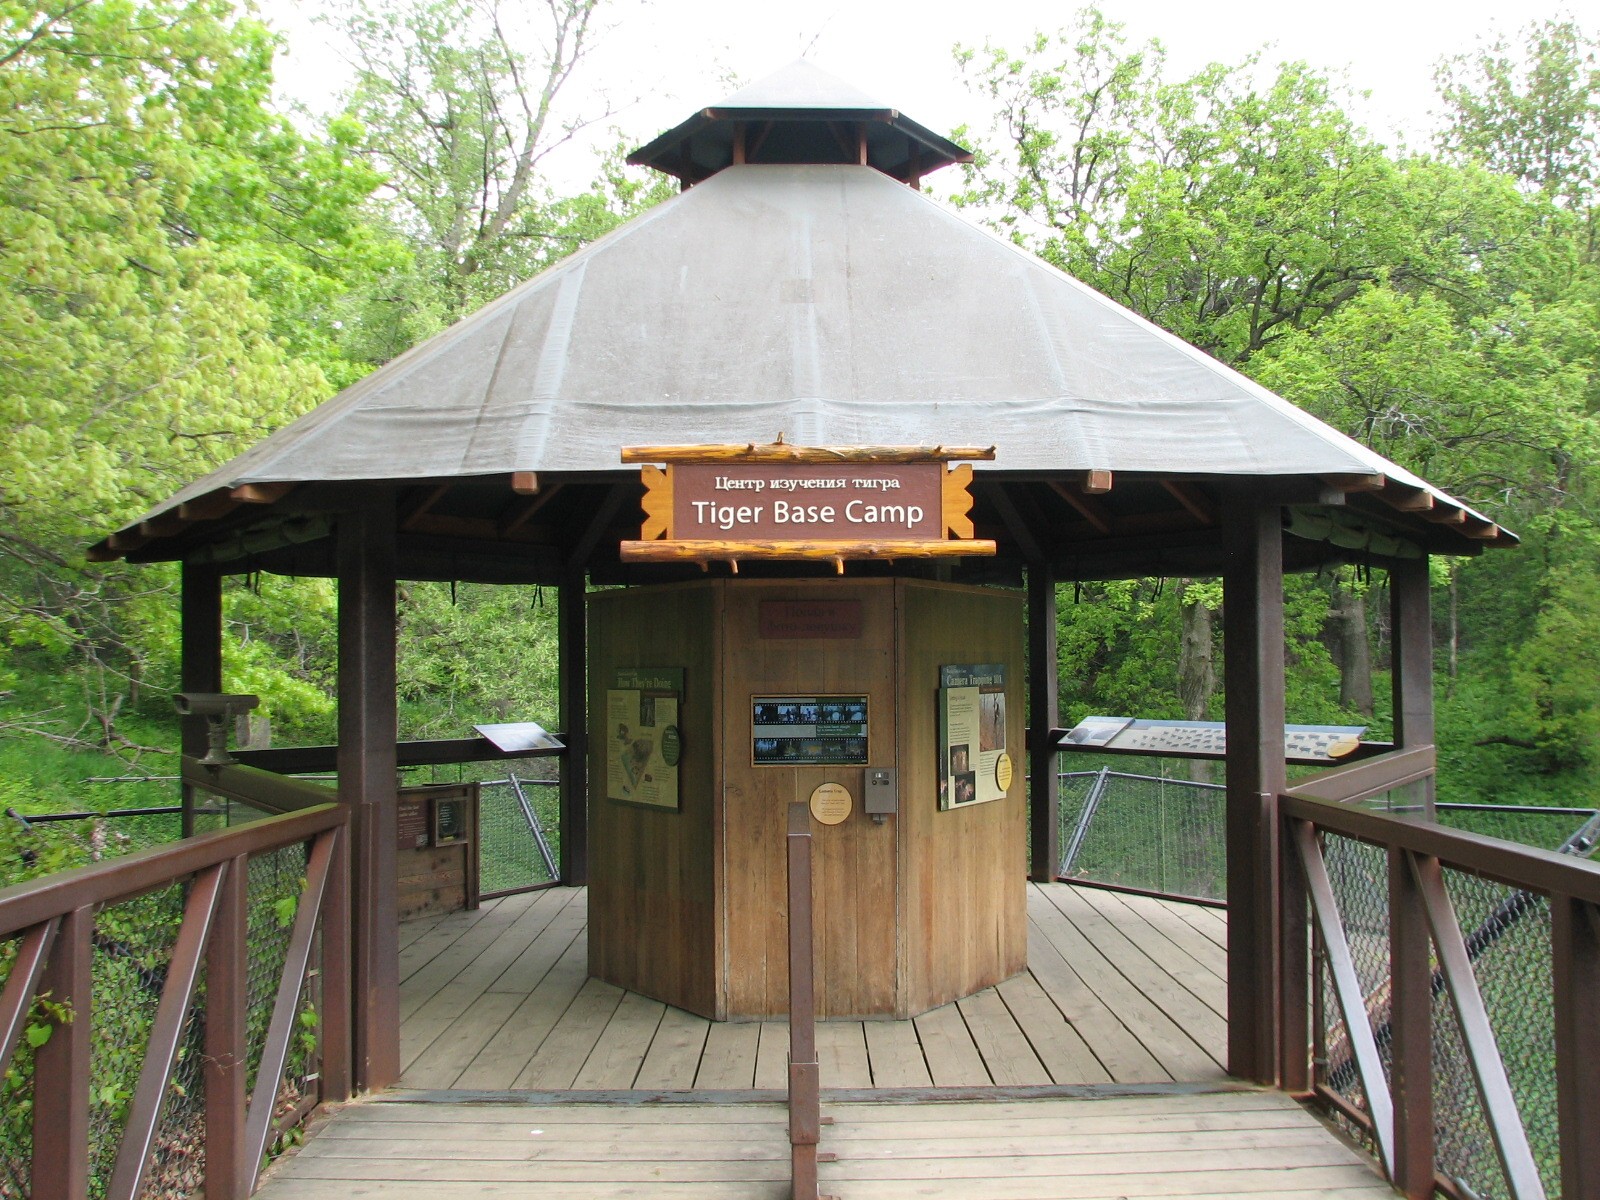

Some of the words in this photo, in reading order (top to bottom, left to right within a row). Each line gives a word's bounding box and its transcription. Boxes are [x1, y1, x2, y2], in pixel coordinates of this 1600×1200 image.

[715, 476, 765, 492] Центр
[770, 478, 847, 492] изучения
[852, 478, 900, 492] тигра
[692, 501, 764, 530] Tiger
[774, 501, 835, 523] Base
[845, 499, 924, 529] Camp
[946, 675, 968, 687] Camera
